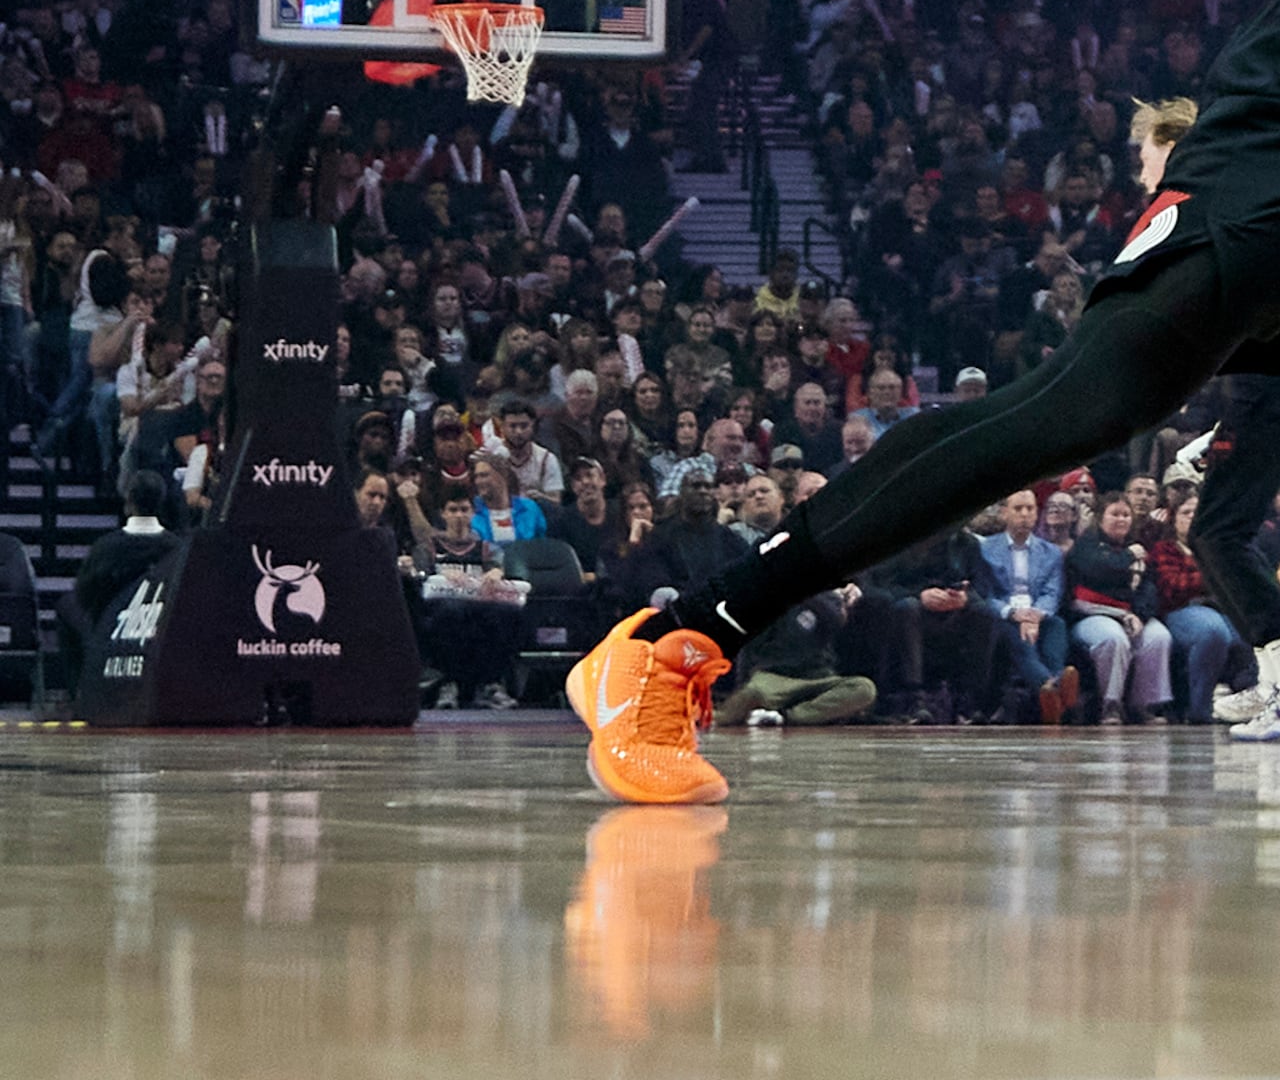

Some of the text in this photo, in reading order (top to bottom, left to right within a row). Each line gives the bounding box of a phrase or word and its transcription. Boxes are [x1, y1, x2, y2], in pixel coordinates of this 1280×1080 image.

[263, 338, 330, 362] xfinity
[252, 457, 334, 487] xfinity
[237, 638, 342, 656] luckin coffee
